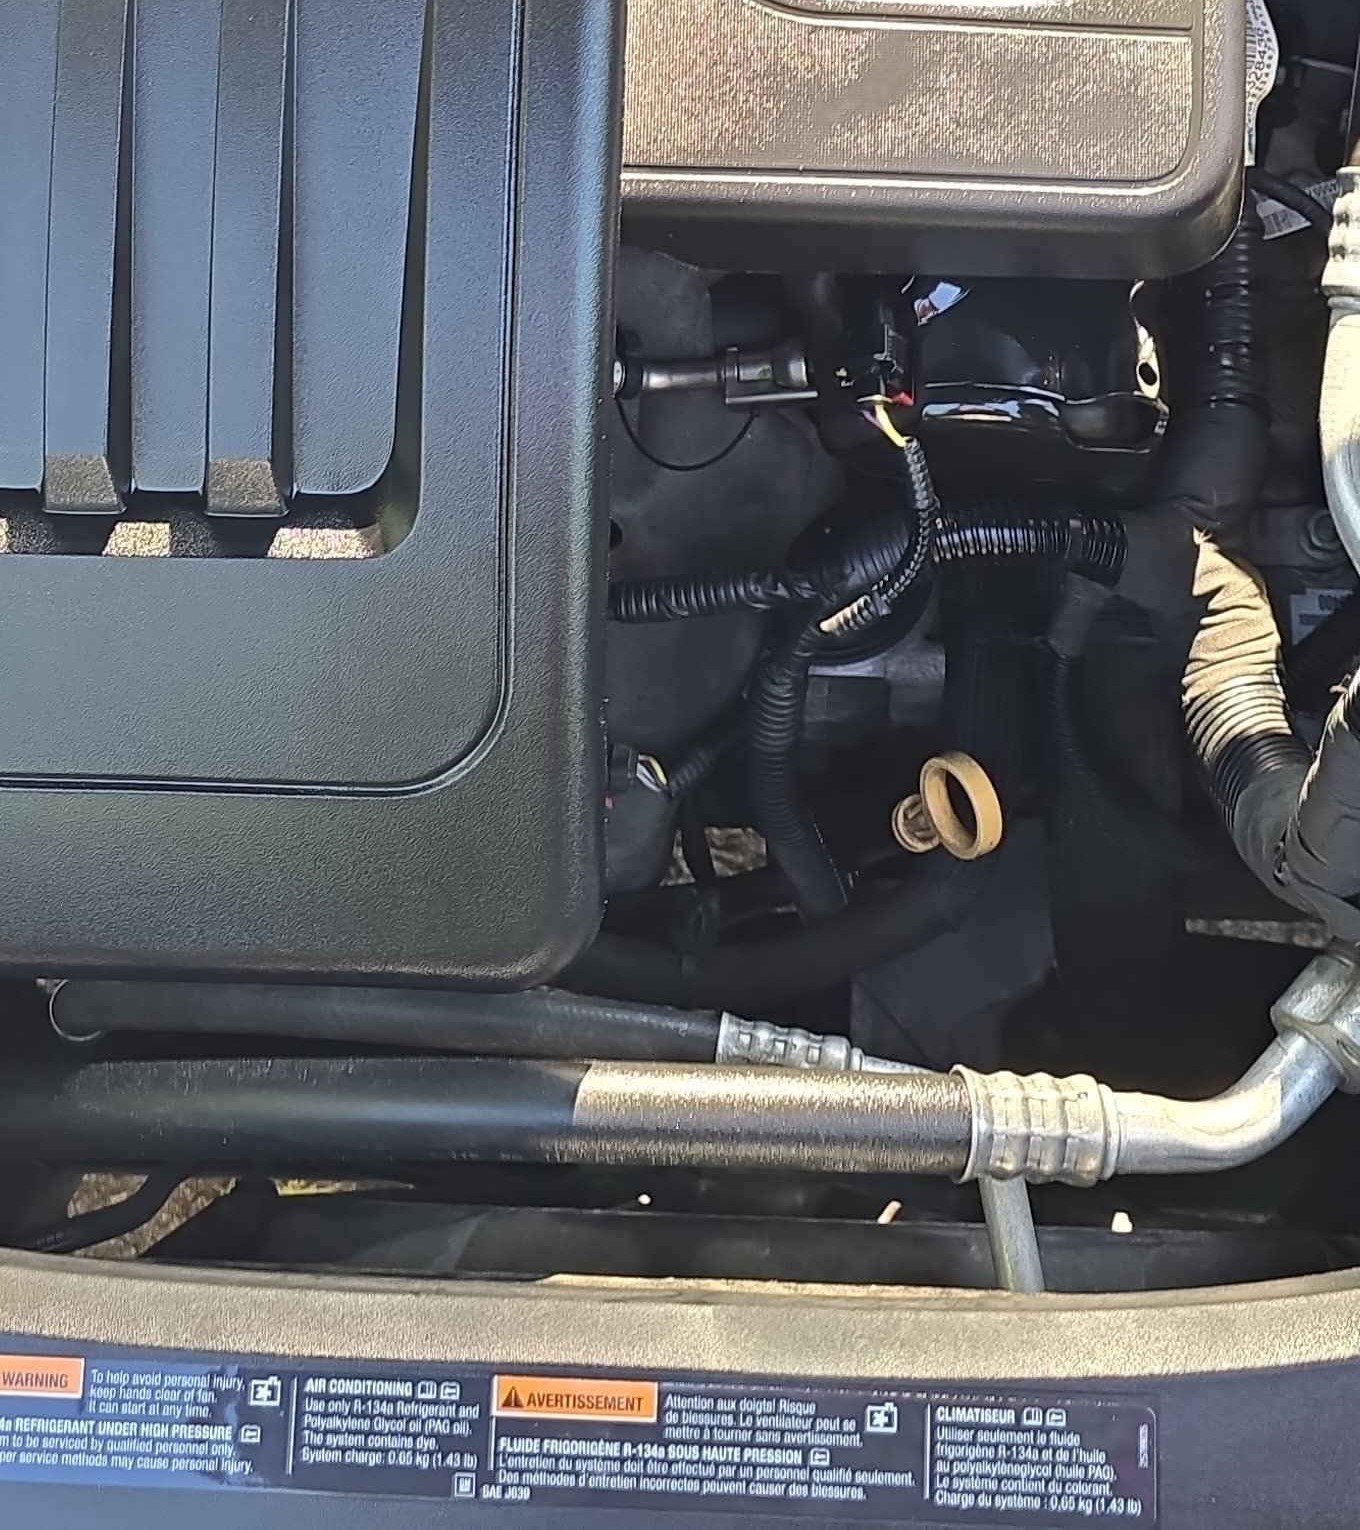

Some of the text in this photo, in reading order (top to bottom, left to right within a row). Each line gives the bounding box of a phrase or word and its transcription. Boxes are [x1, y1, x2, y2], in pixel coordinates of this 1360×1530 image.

[2, 1371, 68, 1388] WARNING
[91, 1370, 245, 1391] To help avoid personal injury.
[305, 1377, 412, 1396] AIR CONDITIONING
[91, 1385, 217, 1403] keep hands clear of fan.
[527, 1392, 644, 1411] AVERTISSEMENT
[99, 1402, 118, 1413] can
[122, 1402, 145, 1415] start
[149, 1404, 159, 1415] at
[163, 1405, 181, 1418] any
[185, 1405, 212, 1417] time.
[305, 1397, 479, 1419] Use only R-134a Refrigerant and
[665, 1394, 816, 1416] Attention aux doigts! Risque
[936, 1406, 1015, 1423] CLIMATISEUR
[15, 1417, 97, 1434] REFRIGERANT
[98, 1422, 137, 1435] UNDER
[141, 1423, 169, 1437] HIGH
[172, 1424, 232, 1439] PRESSURE
[374, 1417, 406, 1433] Glycol
[409, 1418, 421, 1432] oil
[425, 1419, 450, 1435] (PAG
[666, 1411, 856, 1433] de blessures. Le ventilateur peut se
[13, 1433, 23, 1447] to
[26, 1434, 39, 1448] be
[42, 1436, 87, 1450] serviced
[91, 1438, 103, 1452] by
[107, 1439, 153, 1453] qualified
[156, 1440, 208, 1455] personnel
[211, 1441, 236, 1456] only.
[304, 1430, 438, 1450] The system contains dye.
[665, 1425, 700, 1440] mettre
[713, 1427, 752, 1441] tourner
[755, 1430, 780, 1443] sans
[784, 1431, 863, 1447] avertissement.
[937, 1426, 1080, 1446] Utiliser seulement le fluide
[302, 1446, 342, 1464] System
[345, 1448, 385, 1466] charge:
[416, 1451, 429, 1467] kg
[464, 1454, 477, 1470] lb)
[499, 1436, 540, 1454] FLUIDE
[544, 1438, 620, 1456] FRIGORIGÈNE
[668, 1444, 699, 1460] SOUS
[703, 1446, 740, 1462] HAUTE
[744, 1448, 802, 1464] PRESSION
[999, 1444, 1039, 1460] R-134a
[1042, 1446, 1053, 1461] et
[1056, 1447, 1069, 1462] de
[20, 1450, 58, 1464] service
[61, 1453, 107, 1467] methods
[111, 1456, 133, 1469] may
[137, 1457, 168, 1468] cause
[172, 1457, 218, 1471] personal
[222, 1458, 254, 1474] injury.
[559, 1457, 572, 1470] du
[575, 1458, 620, 1474] système
[624, 1459, 643, 1473] doit
[718, 1464, 736, 1479] par
[740, 1465, 753, 1478] un
[757, 1465, 809, 1483] personnel
[855, 1470, 915, 1486] seulement.
[936, 1460, 950, 1473] au
[1056, 1464, 1085, 1480] (huile
[499, 1470, 519, 1483] Des
[640, 1475, 699, 1493] incorrectes
[703, 1478, 746, 1495] peuvent
[750, 1480, 785, 1496] causer
[789, 1481, 808, 1497] des
[811, 1483, 867, 1500] blessures.
[936, 1475, 1112, 1496] Le système contient du colorant.
[935, 1491, 974, 1509] Charge
[979, 1492, 991, 1507] du
[995, 1494, 1039, 1510] système
[1079, 1497, 1092, 1515] kg
[1127, 1498, 1142, 1516] lb)
